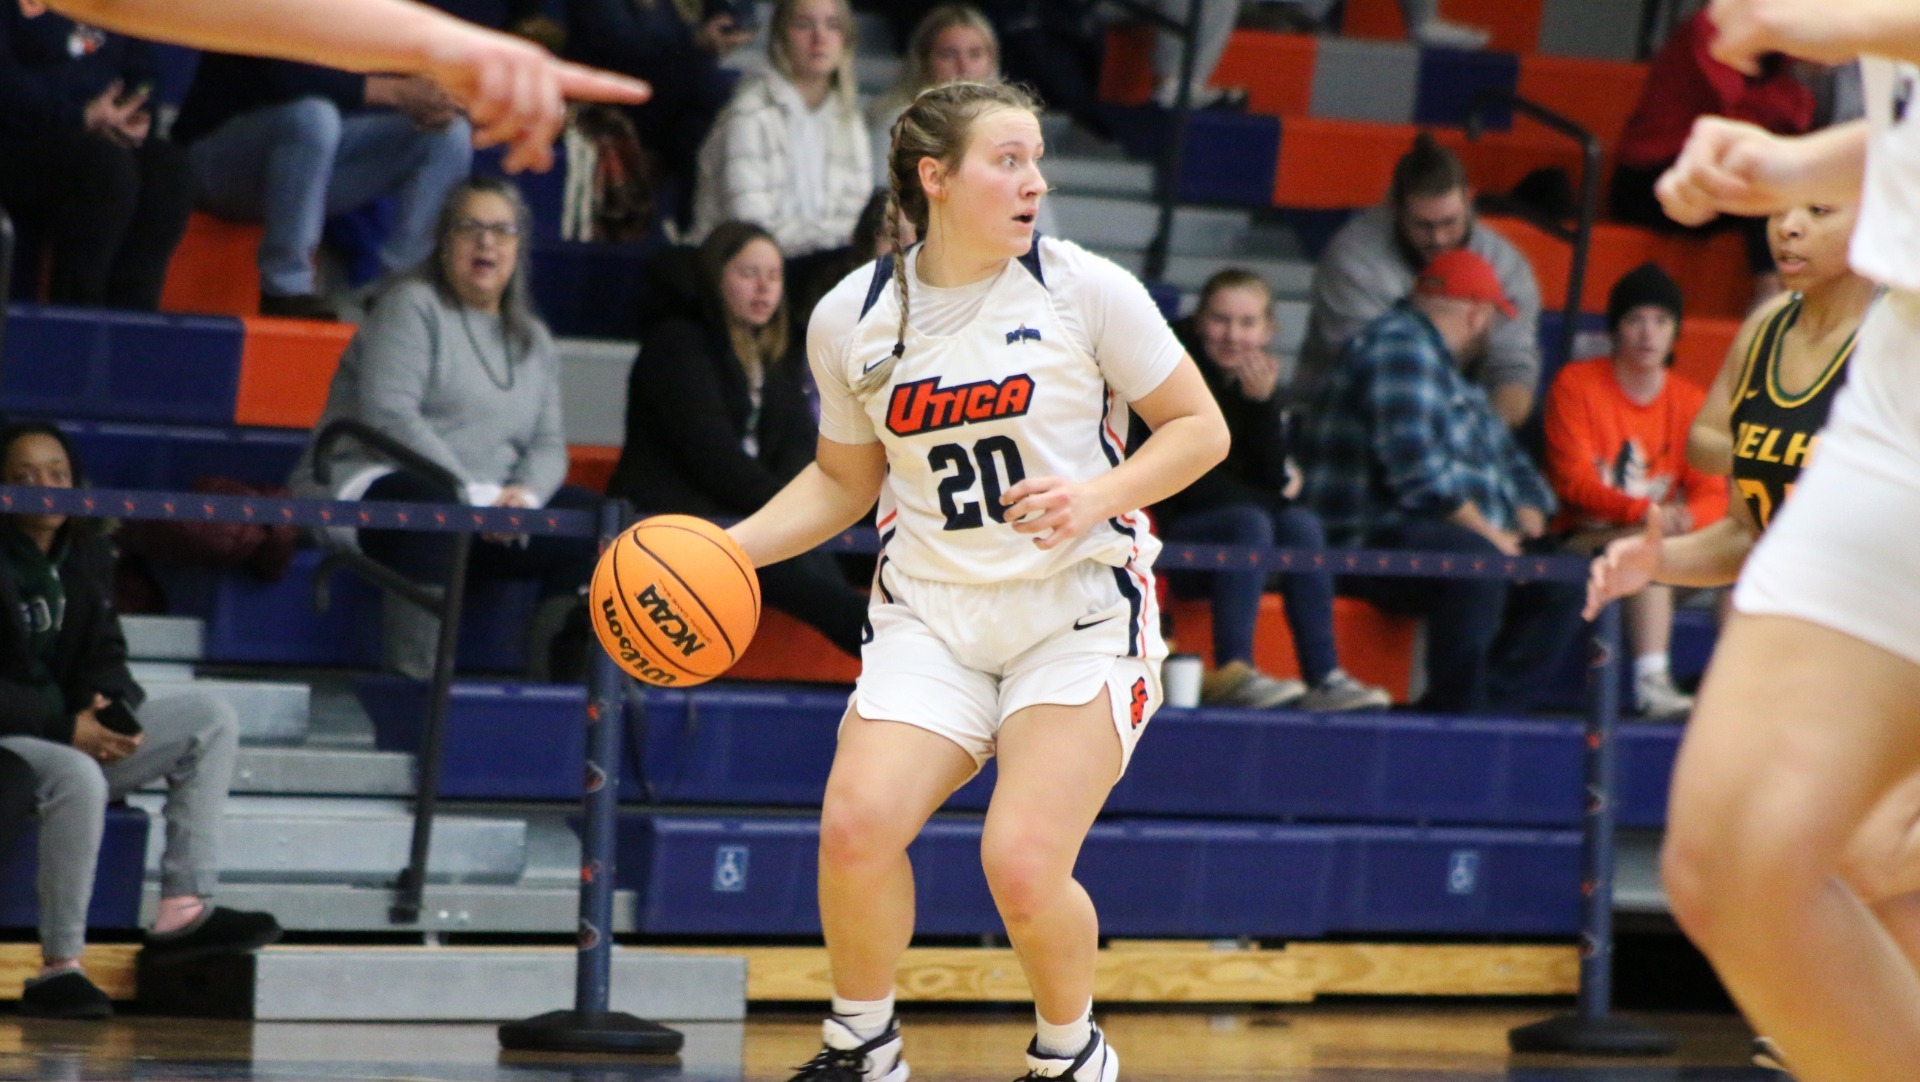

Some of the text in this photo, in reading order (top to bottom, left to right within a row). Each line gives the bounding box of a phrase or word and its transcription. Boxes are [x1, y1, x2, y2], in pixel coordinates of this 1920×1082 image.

[885, 374, 1035, 437] UTICA
[927, 435, 1026, 531] 20
[602, 596, 677, 685] Wilson
[636, 583, 706, 657] NCAA
